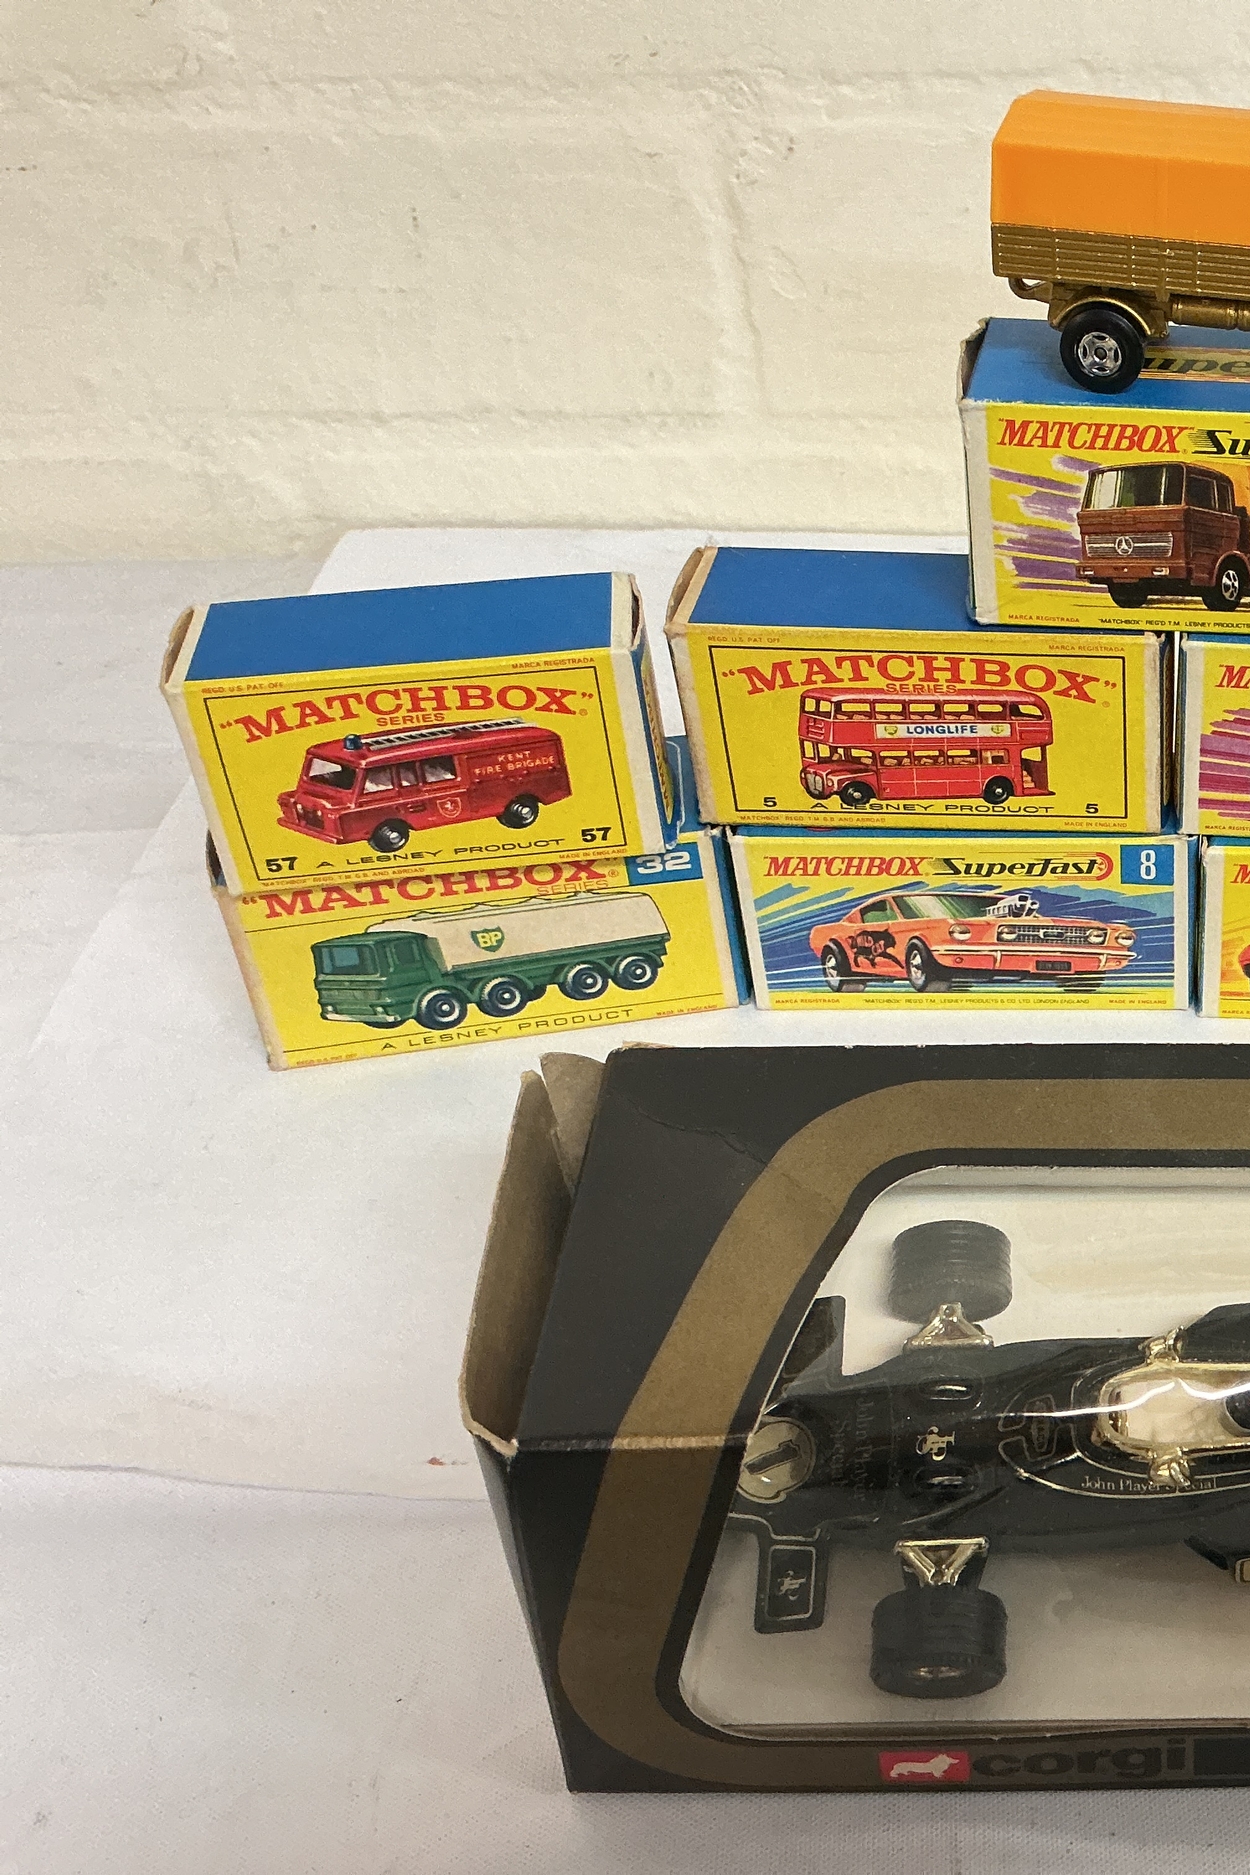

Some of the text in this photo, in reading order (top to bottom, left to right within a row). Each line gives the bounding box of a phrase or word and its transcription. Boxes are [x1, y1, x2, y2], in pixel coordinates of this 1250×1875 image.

[1008, 613, 1080, 624] MARCA REGISTRADA
[1213, 622, 1250, 630] PRODUCTS
[1078, 645, 1125, 653] REGISTRADA
[511, 657, 595, 670] MARCA REGISTRADA
[885, 683, 958, 696] SERIES
[377, 713, 446, 727] SERIES
[906, 724, 979, 735] LONGLIFE
[498, 750, 532, 763] KENT
[474, 755, 556, 776] FIRE BRIGADE
[763, 796, 778, 808] 5
[810, 802, 1055, 814] A LESNEY PRODUCT
[1085, 803, 1099, 815] 5
[1095, 821, 1128, 829] ENGLAND
[581, 826, 612, 843] 57
[316, 838, 566, 869] A LESNEY PRODUCT
[266, 856, 299, 873] 57
[635, 851, 692, 875] 32
[932, 857, 1099, 878] Superfast
[1139, 849, 1157, 880] 8
[536, 879, 609, 896] SERIES
[476, 931, 503, 949] BP
[382, 1008, 634, 1051] A LESNEY PRODUCT
[1081, 1475, 1116, 1491] John
[971, 1737, 1187, 1779] corgi
